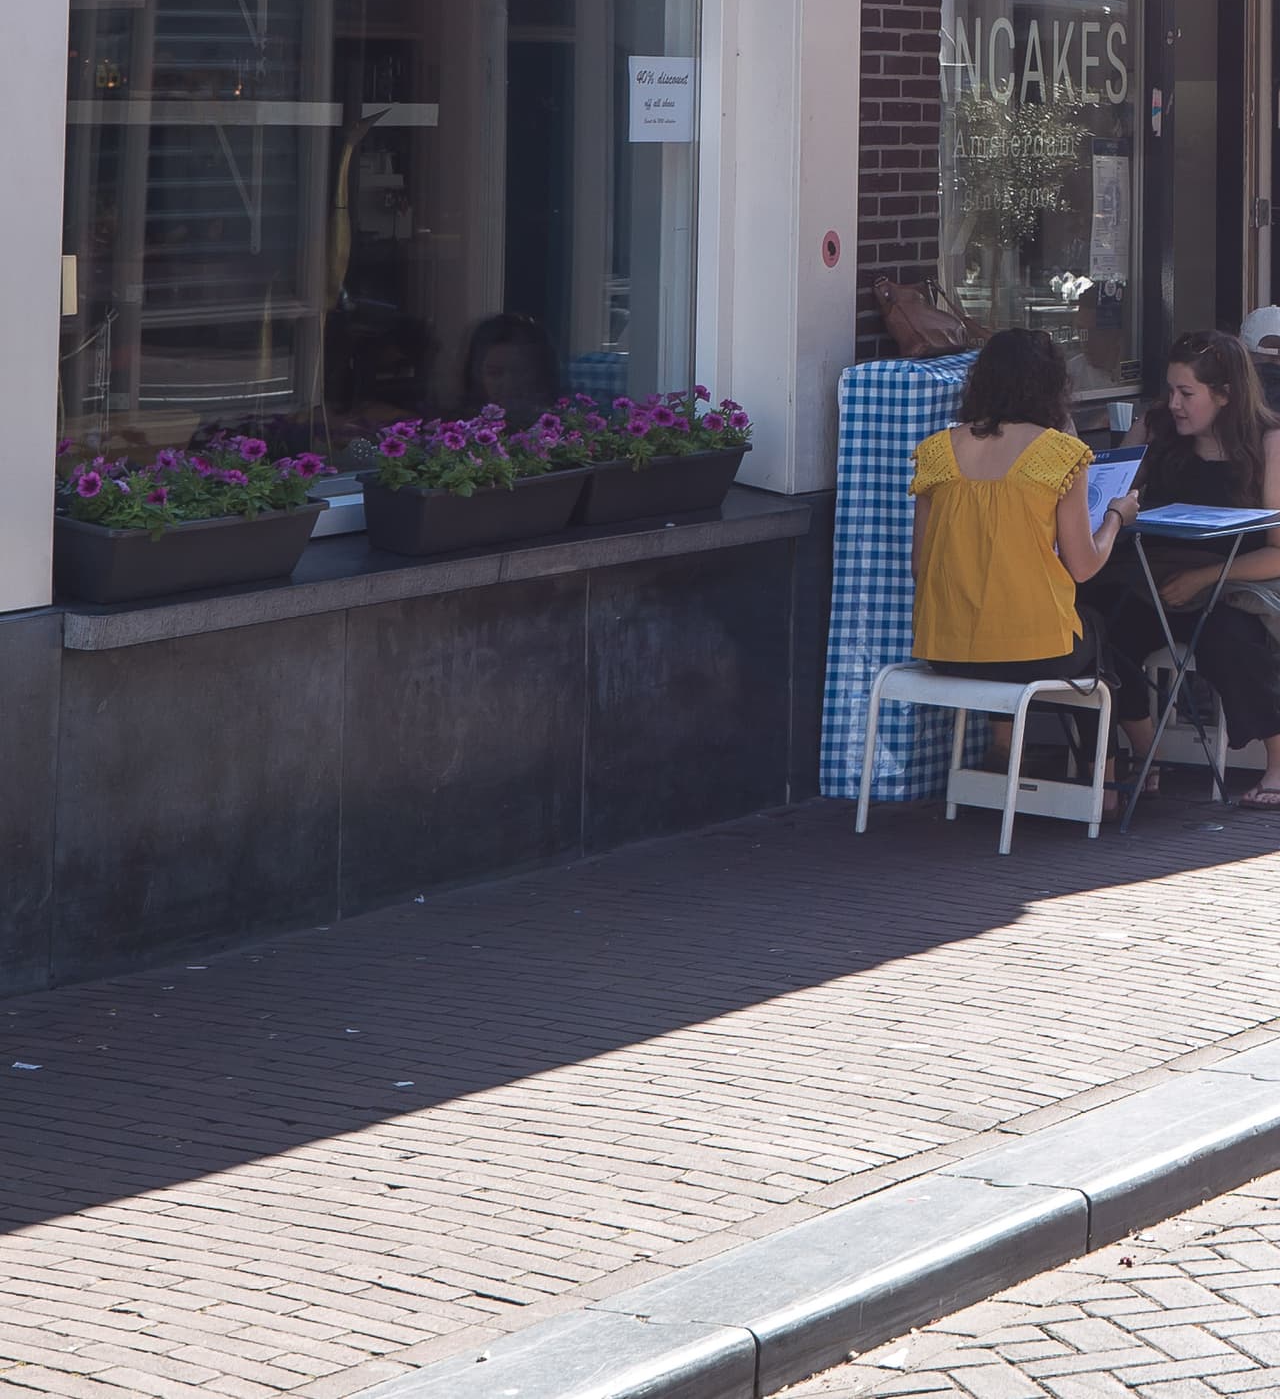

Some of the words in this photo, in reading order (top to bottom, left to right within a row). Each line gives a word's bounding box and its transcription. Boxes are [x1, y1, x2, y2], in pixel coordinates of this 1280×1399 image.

[636, 69, 655, 85] 40%
[657, 71, 689, 85] discount
[952, 127, 1078, 159] Amsterdam
